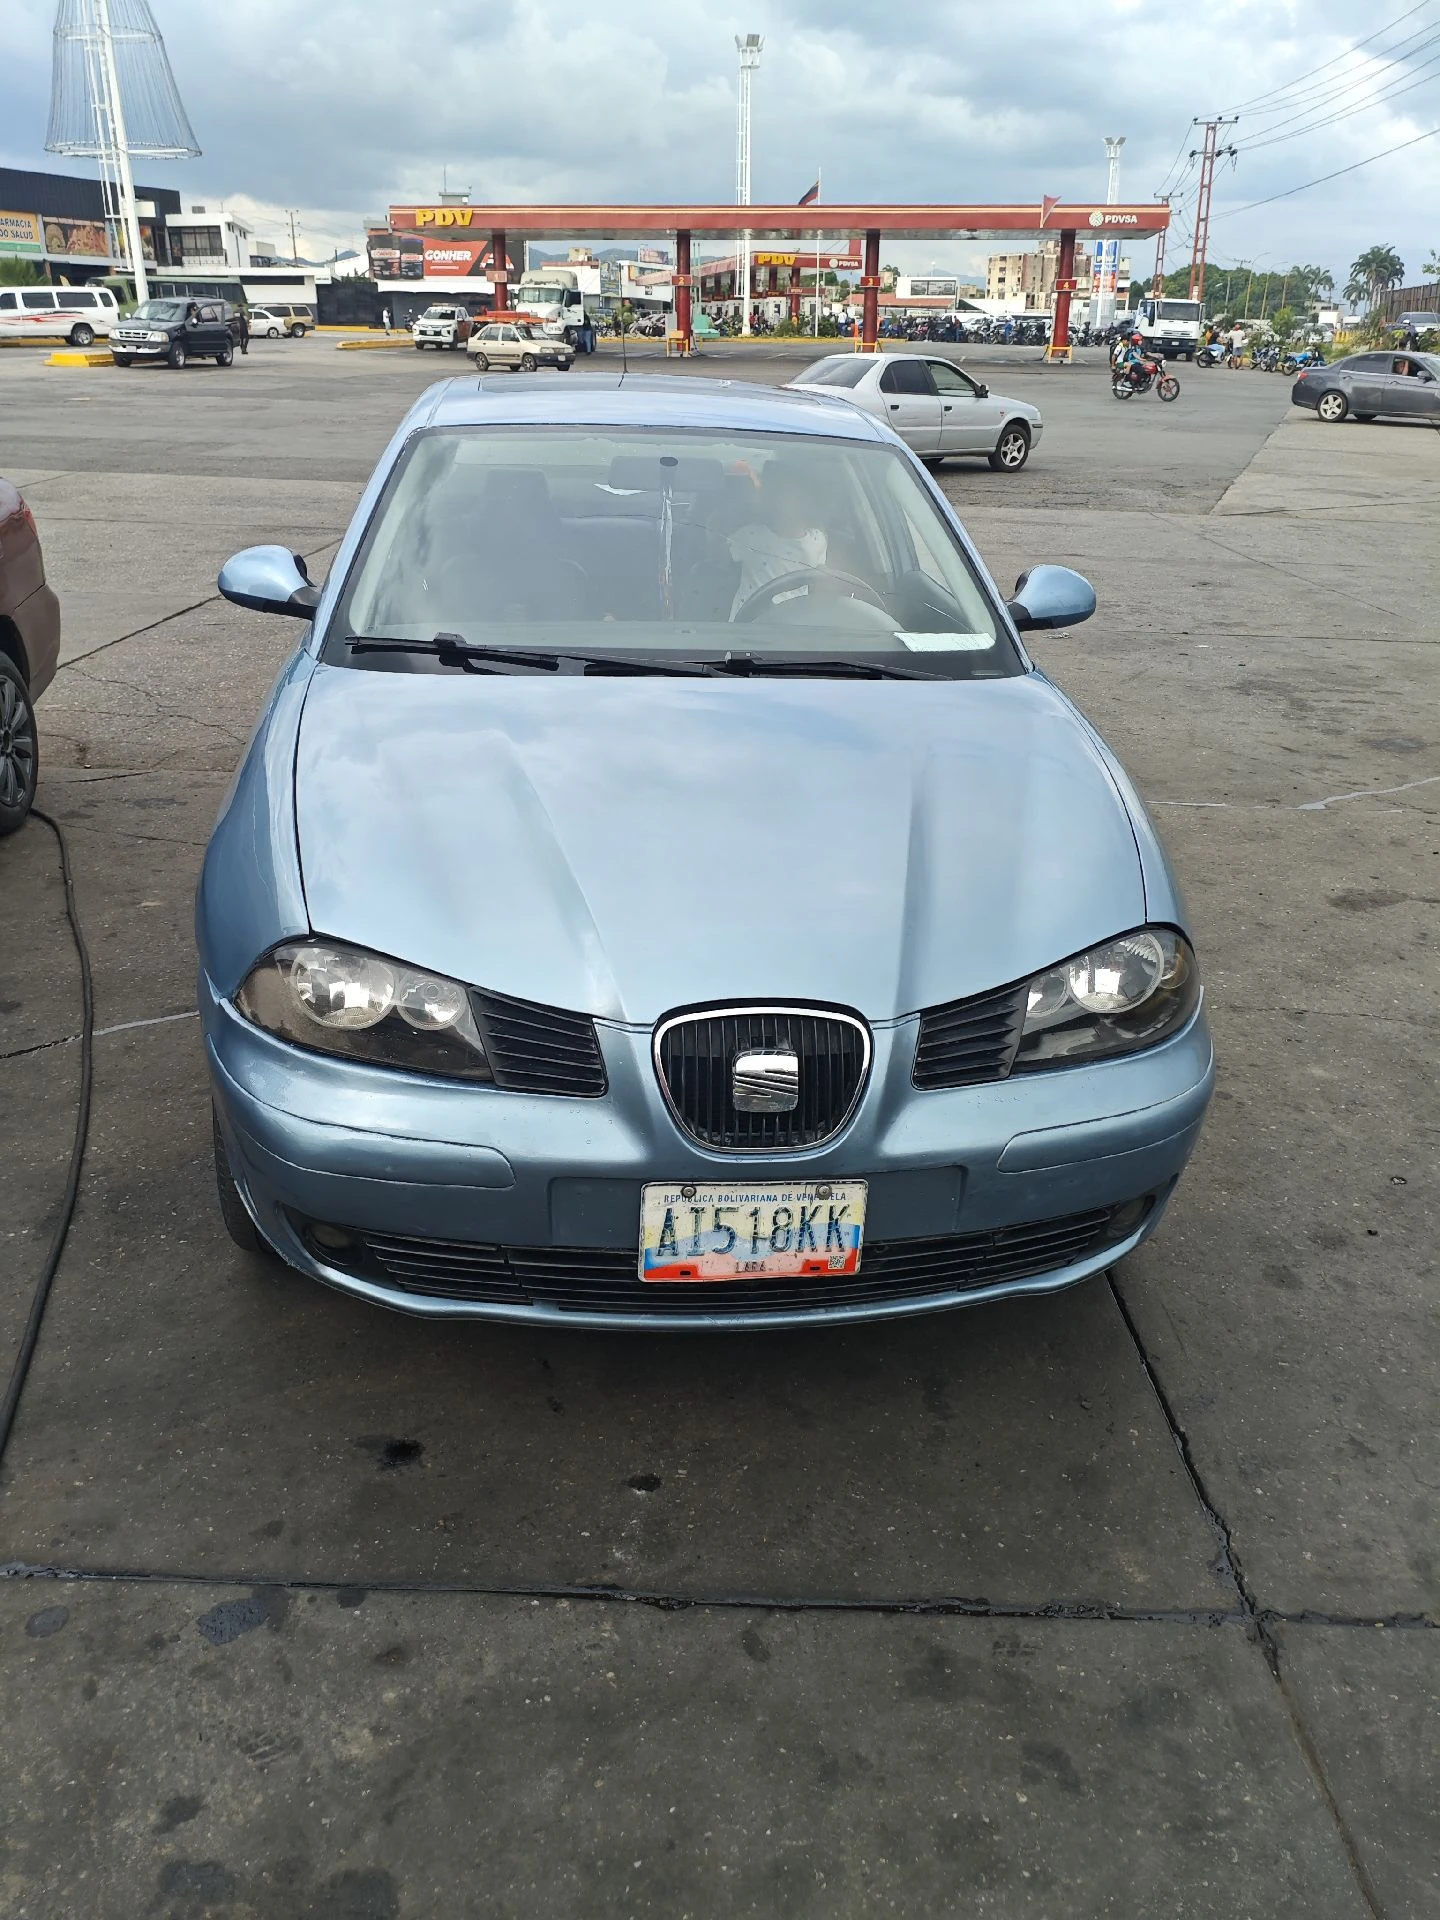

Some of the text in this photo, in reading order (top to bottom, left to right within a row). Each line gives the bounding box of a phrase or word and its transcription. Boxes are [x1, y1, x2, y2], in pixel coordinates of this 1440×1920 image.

[416, 208, 473, 226] PDV
[1105, 215, 1137, 223] PDVSA
[0, 218, 32, 228] ARMACIA
[11, 230, 33, 239] SALUD
[425, 250, 471, 261] GONHER
[757, 254, 796, 265] PDV
[1063, 281, 1070, 289] 4
[718, 1194, 778, 1203] BOLIVARIANA
[781, 1193, 793, 1202] DE
[796, 1192, 847, 1202] VENEELA
[656, 1204, 850, 1257] AI518KK
